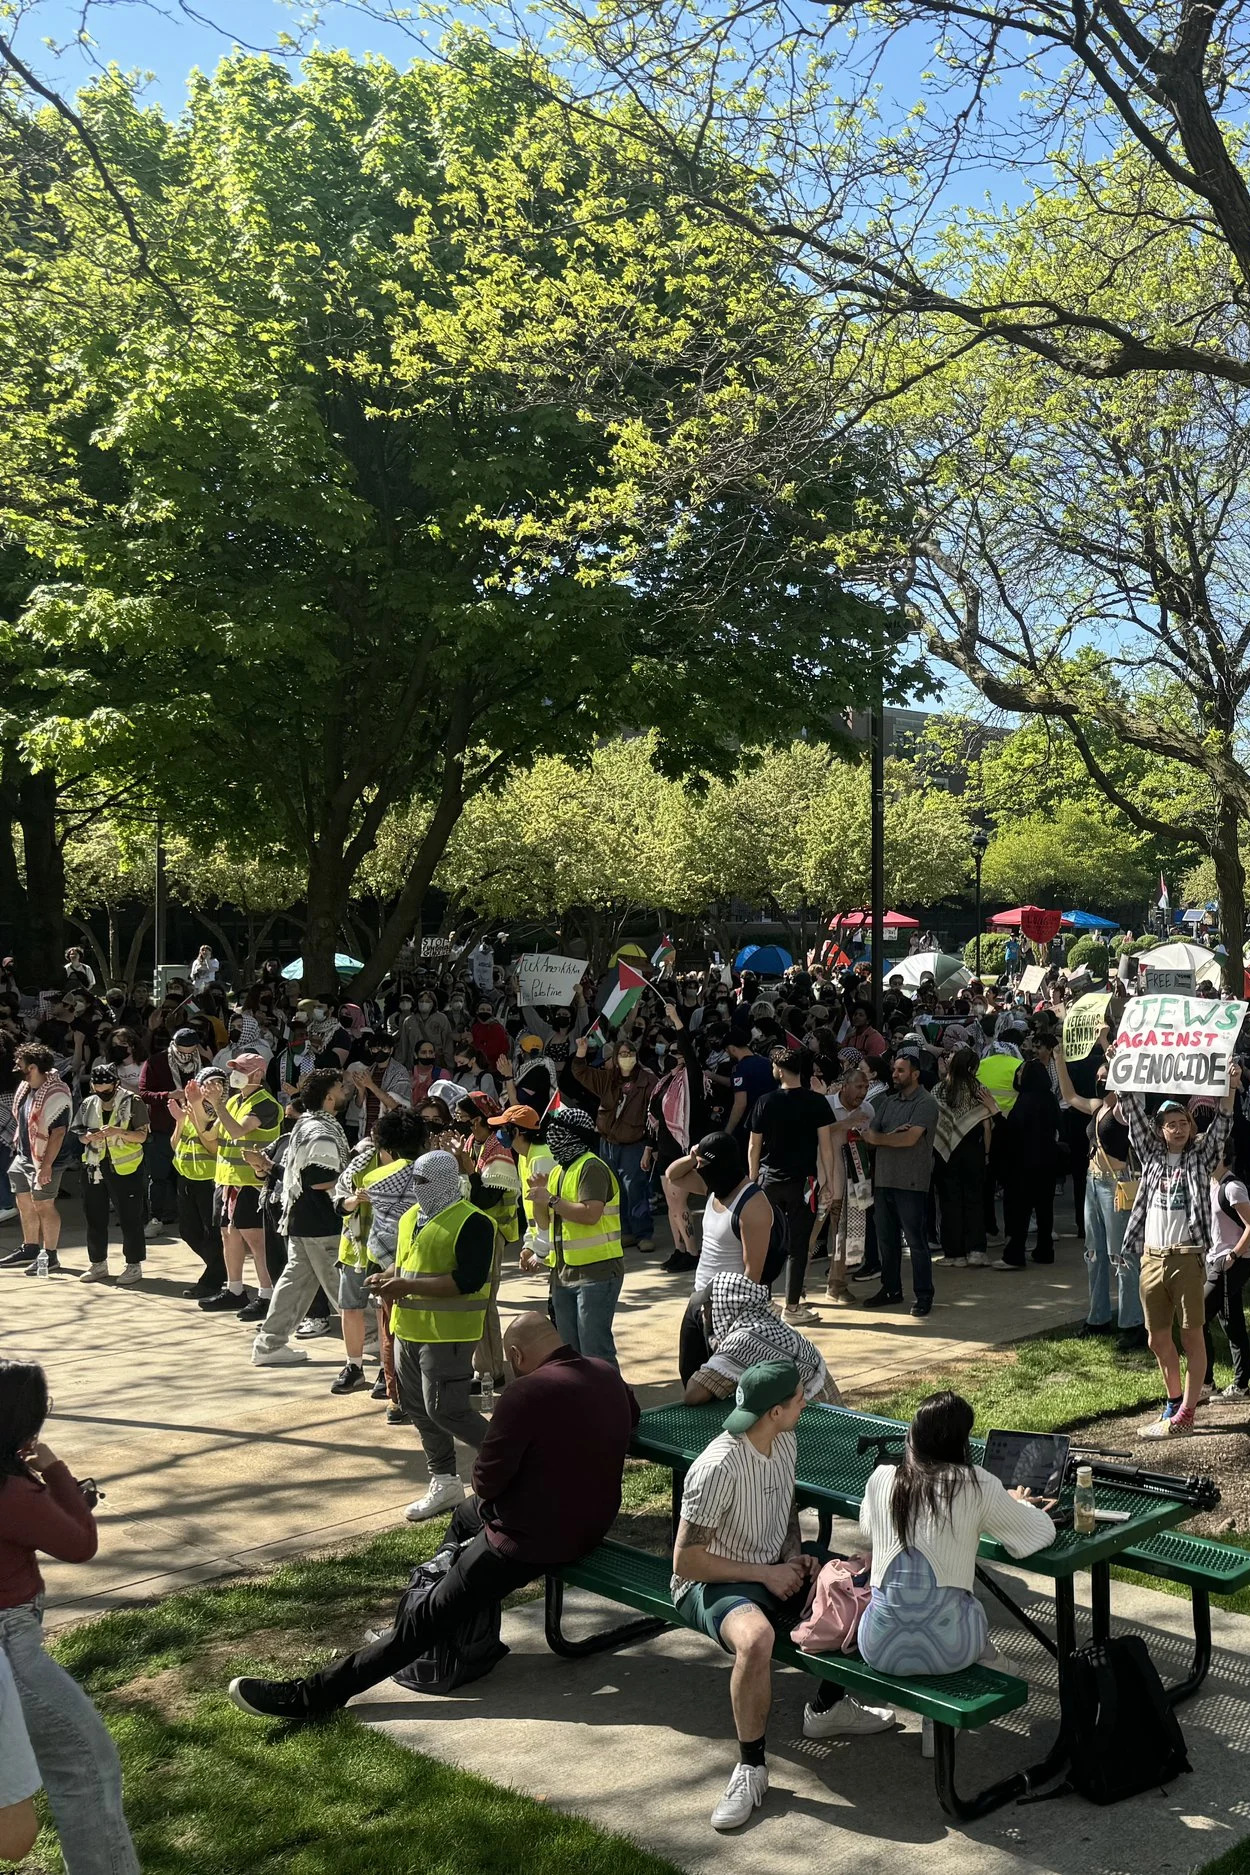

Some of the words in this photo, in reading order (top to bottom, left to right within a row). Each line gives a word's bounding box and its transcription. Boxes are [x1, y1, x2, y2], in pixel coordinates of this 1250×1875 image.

[1146, 972, 1172, 989] FREE
[1127, 997, 1241, 1032] JEWS
[1116, 1030, 1218, 1048] AGAINST
[1112, 1052, 1226, 1085] GENOCIDE
